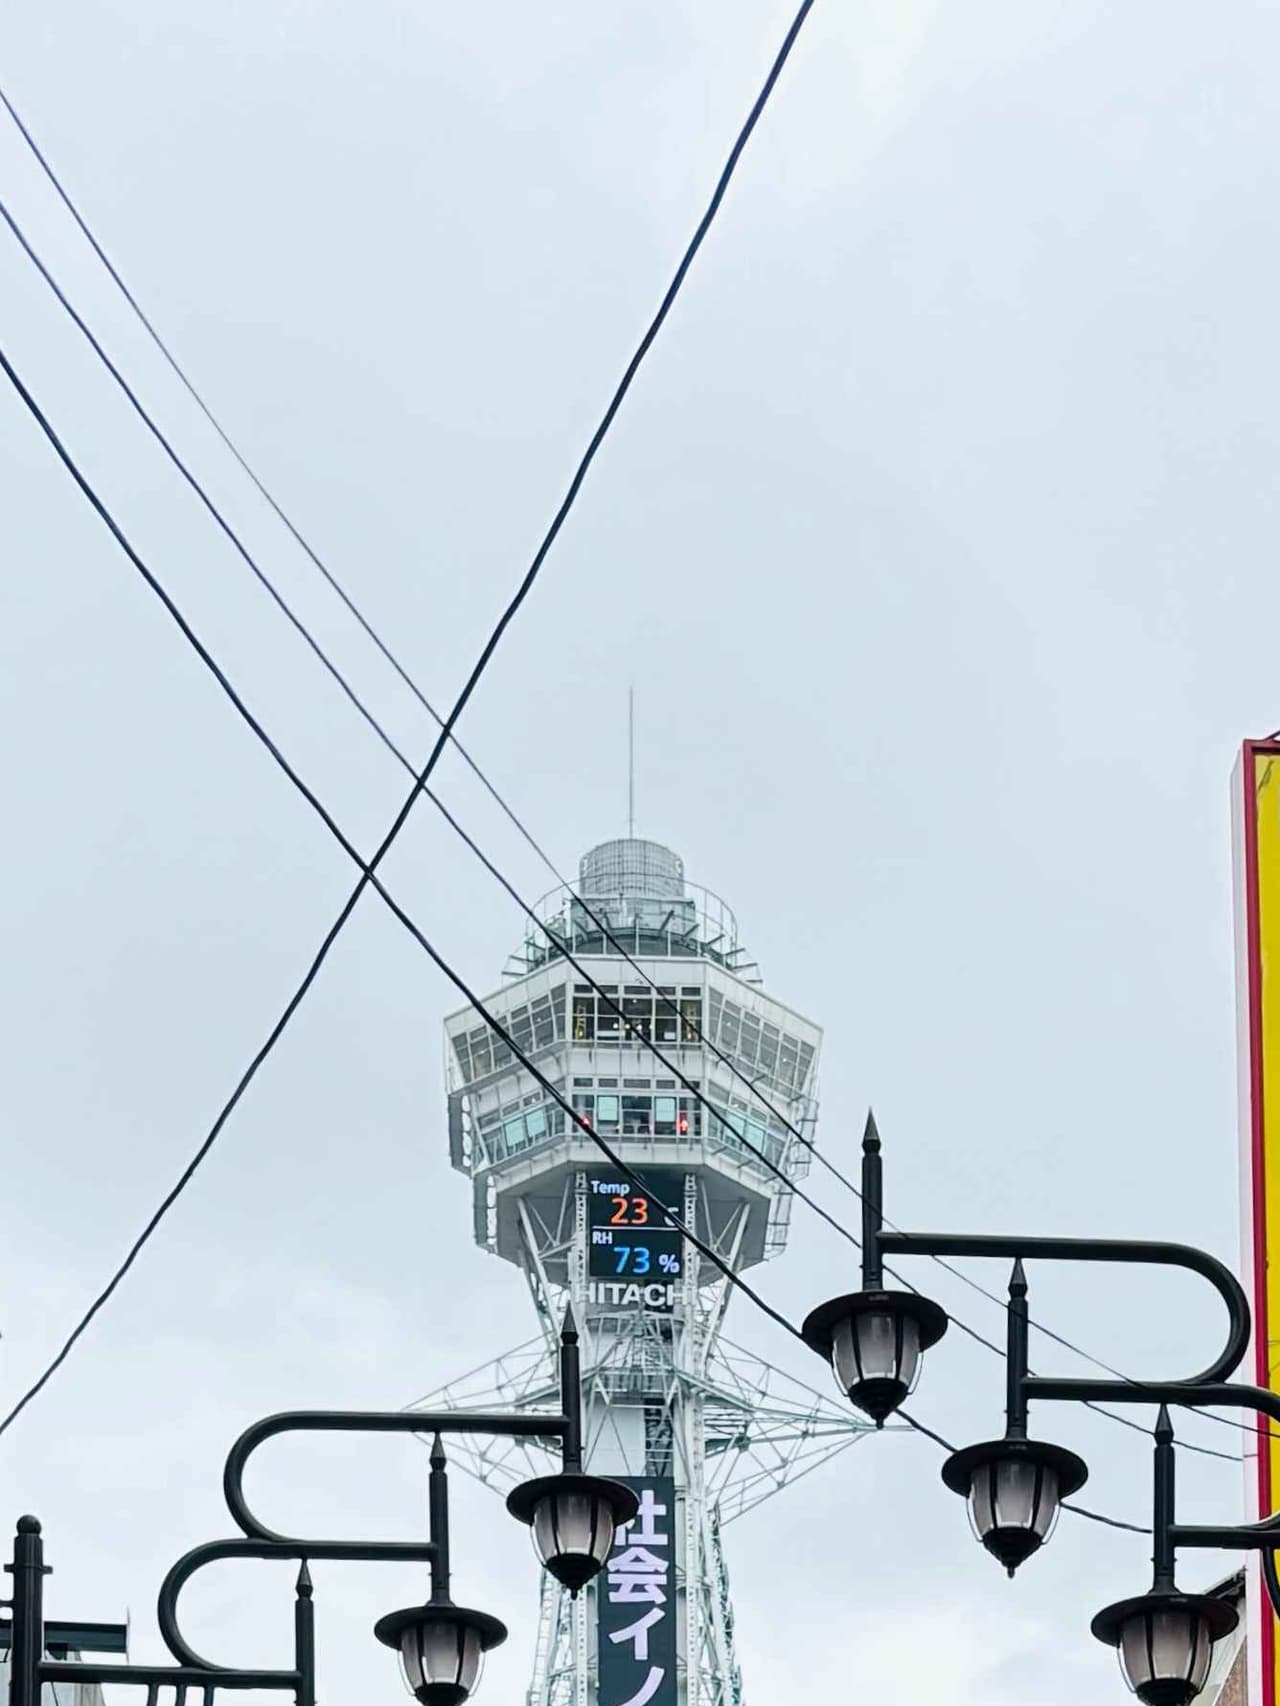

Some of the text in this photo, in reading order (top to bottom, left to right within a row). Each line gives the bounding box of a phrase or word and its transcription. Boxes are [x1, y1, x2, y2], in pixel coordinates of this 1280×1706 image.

[591, 1180, 630, 1197] Temp
[610, 1197, 648, 1224] 23
[592, 1231, 613, 1244] RH
[613, 1246, 680, 1274] 73 %
[575, 1282, 699, 1307] HITACH
